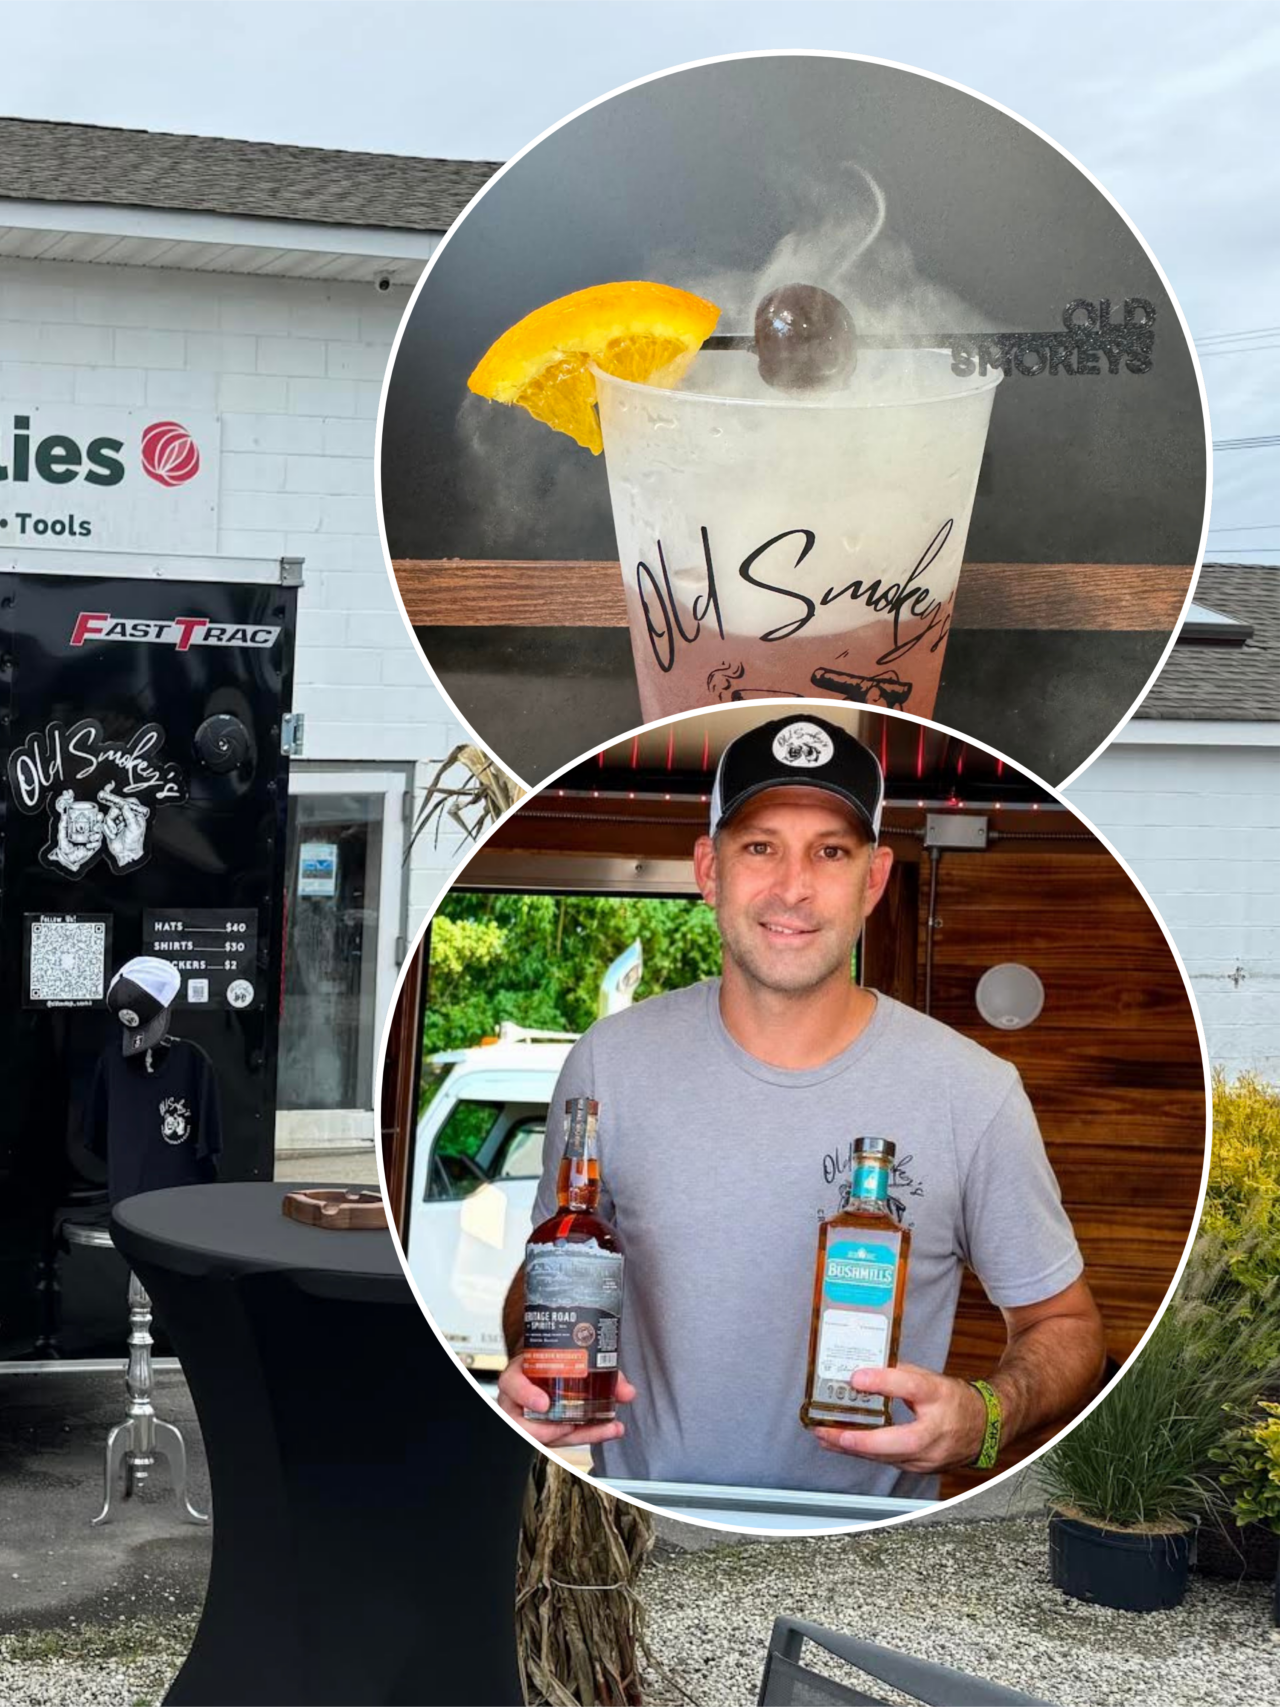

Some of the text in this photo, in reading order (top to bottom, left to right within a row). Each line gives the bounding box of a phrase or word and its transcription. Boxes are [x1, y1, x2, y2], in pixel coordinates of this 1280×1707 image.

[1063, 298, 1157, 332] OLD
[950, 331, 1155, 377] SMOKEYS
[15, 512, 92, 537] Tools
[636, 526, 725, 672] Old
[17, 727, 180, 806] Old Smokey's
[154, 921, 247, 933] HATS $40
[153, 940, 246, 952] SHIRTS $30
[172, 960, 238, 971] CKERS $2
[823, 1142, 852, 1184] Old
[827, 1262, 893, 1283] BUSHMILLS
[552, 1311, 577, 1322] ROAD
